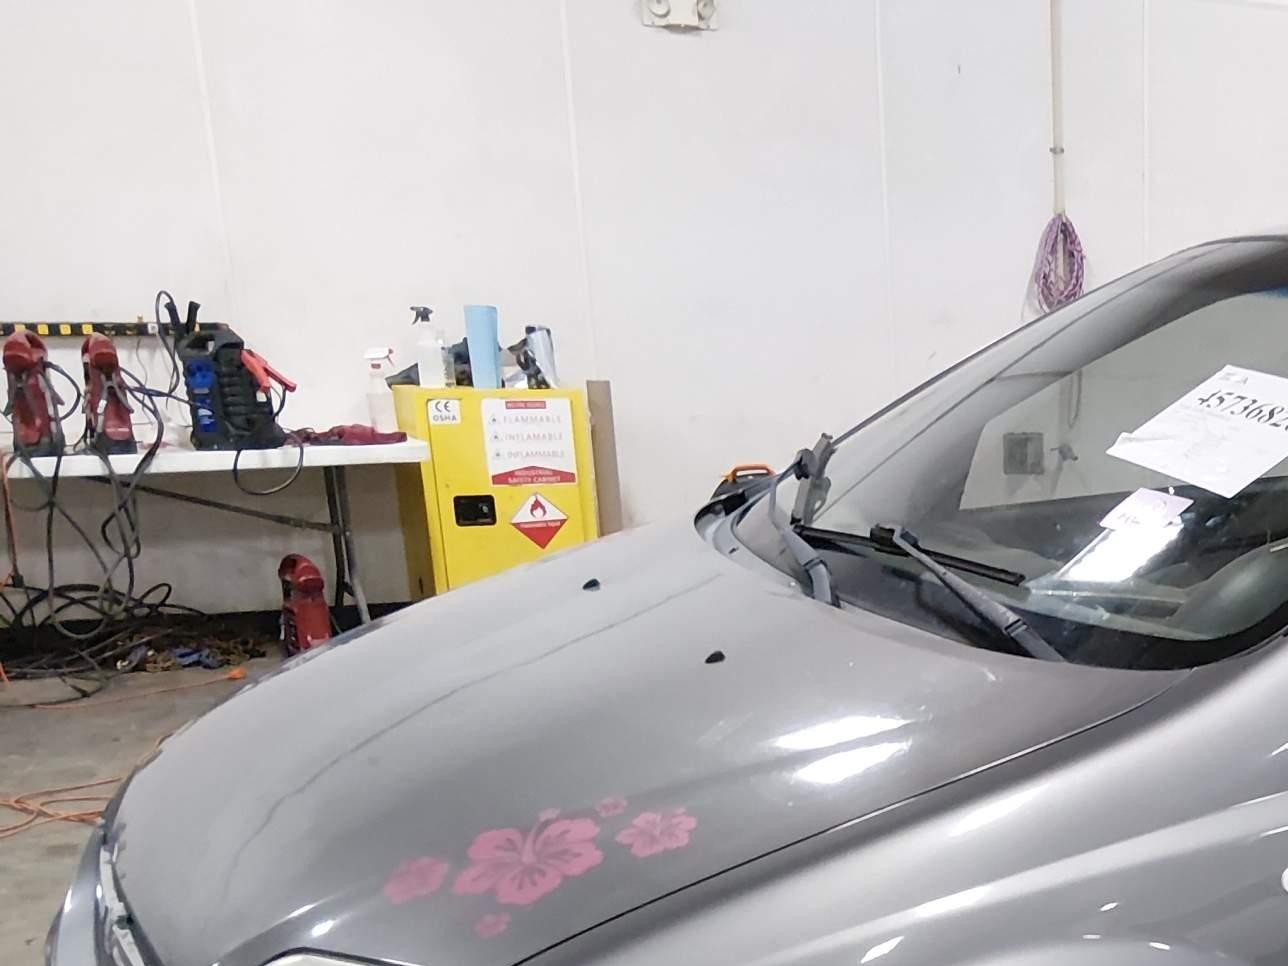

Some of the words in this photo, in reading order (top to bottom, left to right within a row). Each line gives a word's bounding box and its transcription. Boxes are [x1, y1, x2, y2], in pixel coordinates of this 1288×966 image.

[434, 401, 451, 413] CE
[432, 414, 457, 422] OSHA
[503, 416, 561, 424] FLAMMABLE
